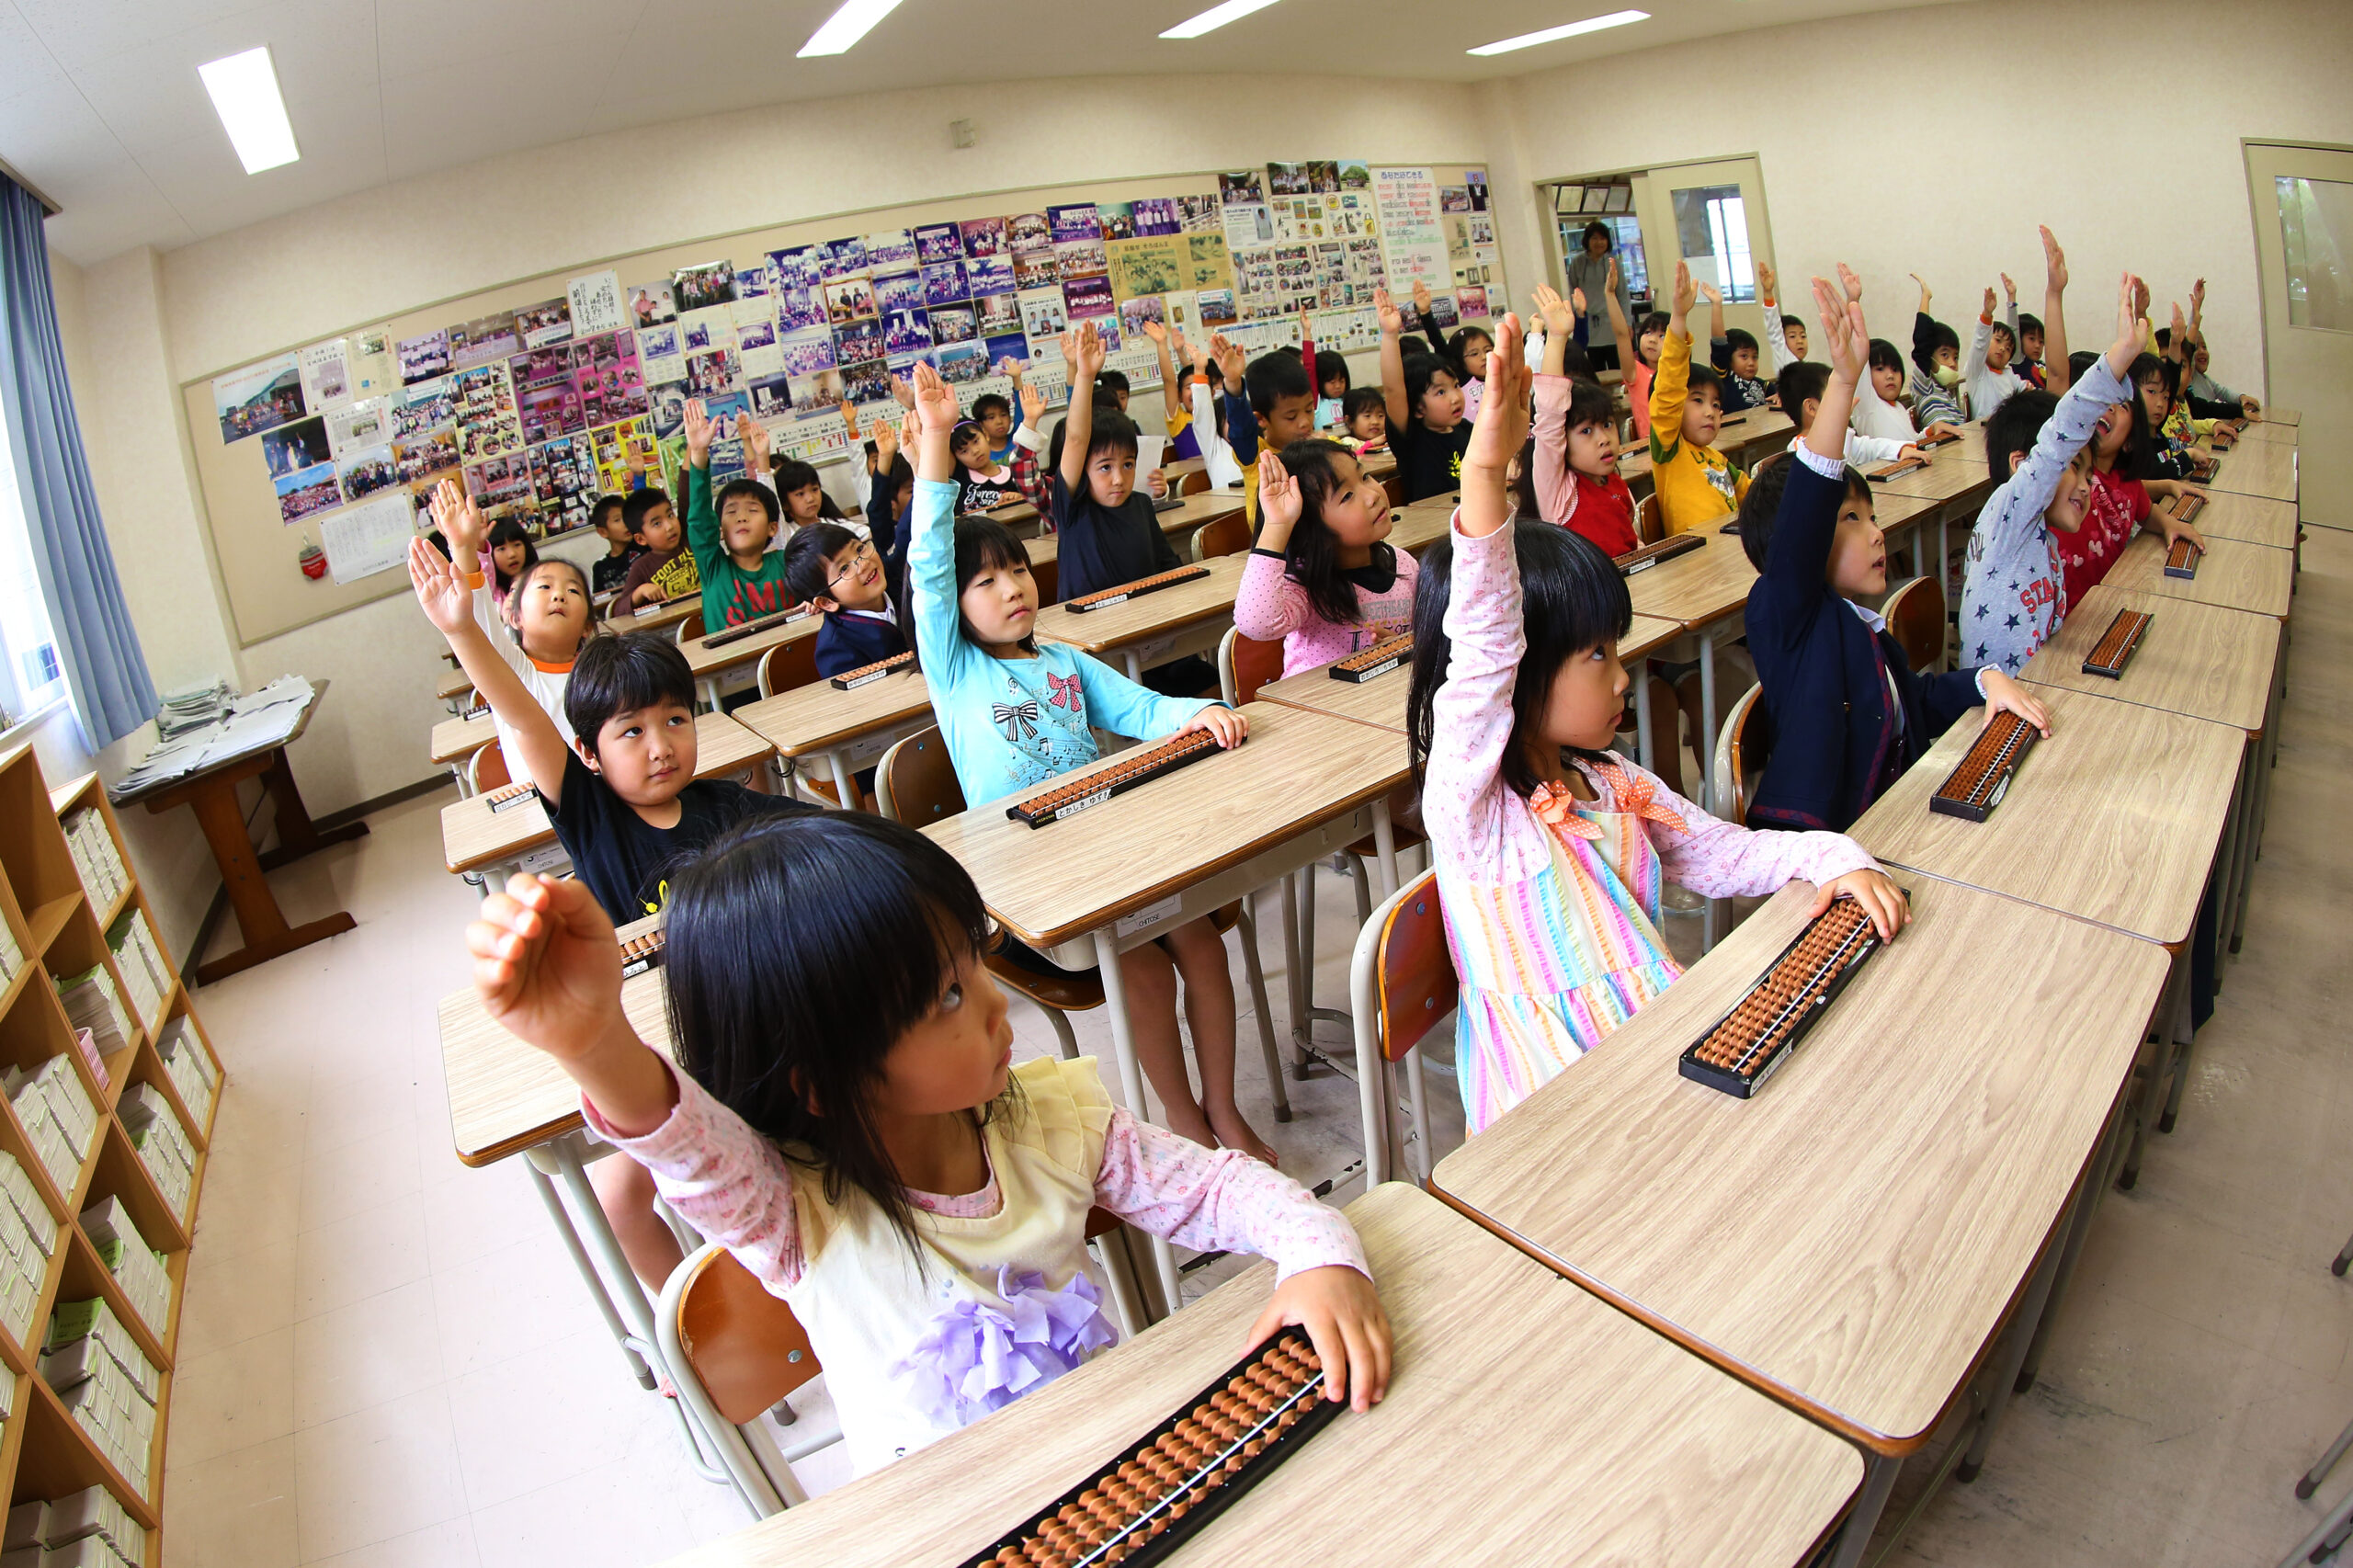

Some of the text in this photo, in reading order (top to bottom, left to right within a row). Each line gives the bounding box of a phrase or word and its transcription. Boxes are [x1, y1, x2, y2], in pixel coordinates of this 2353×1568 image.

[1381, 171, 1424, 180] あなたはできる
[651, 558, 676, 585] FOOT
[1059, 801, 1085, 817] とかしき
[1139, 913, 1160, 926] CHITOSE
